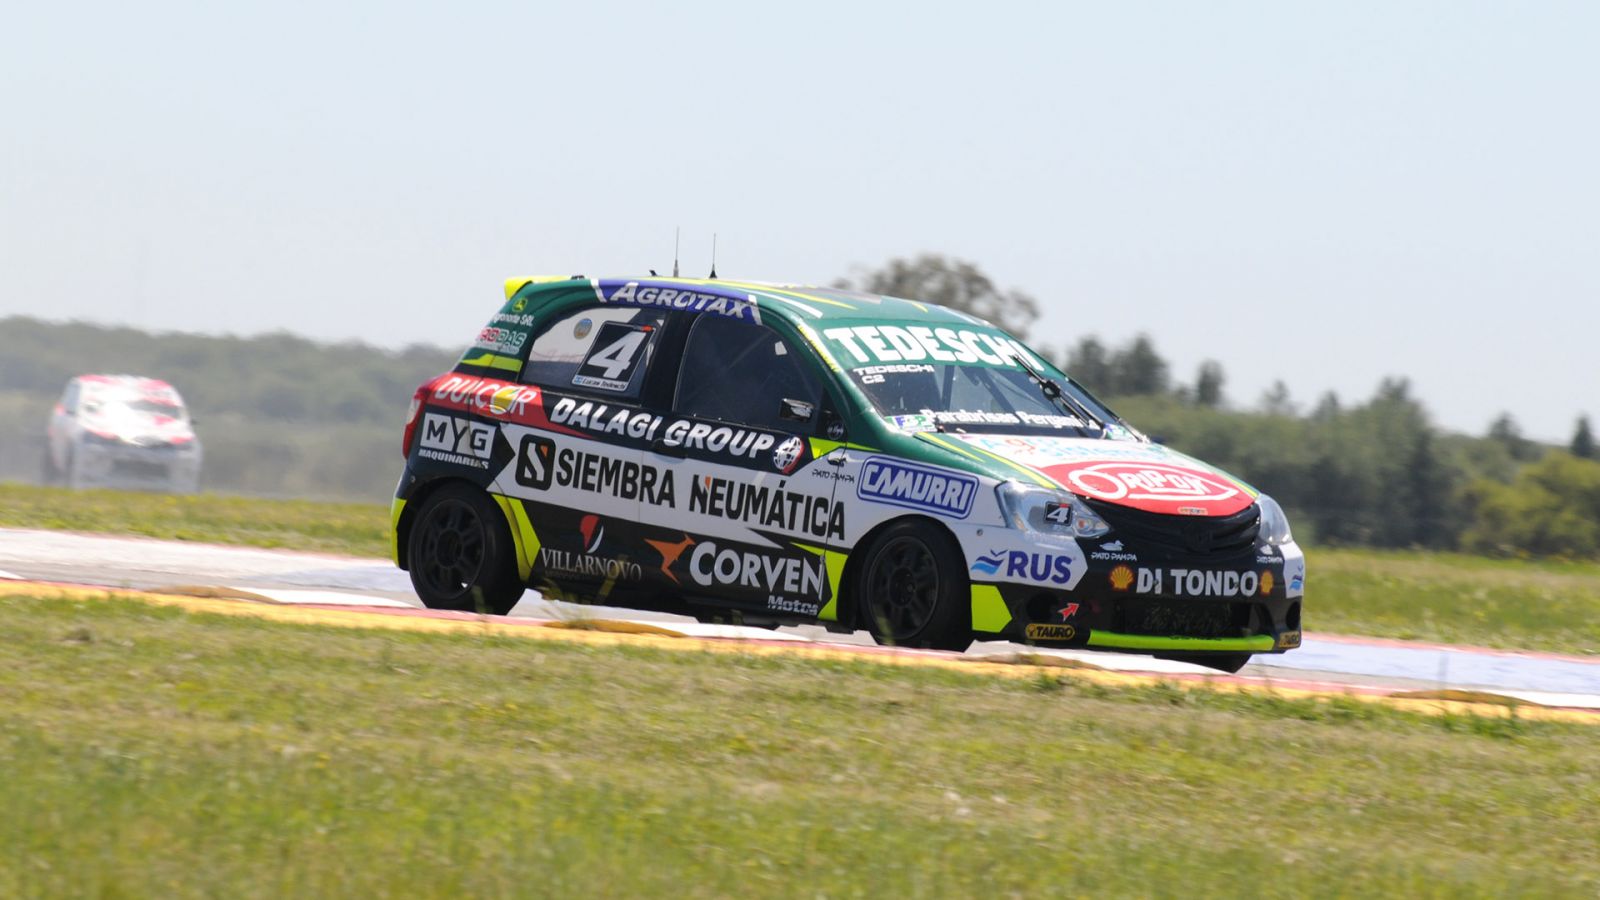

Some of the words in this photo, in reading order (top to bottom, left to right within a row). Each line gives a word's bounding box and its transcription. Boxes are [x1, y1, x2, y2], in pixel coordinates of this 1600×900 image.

[609, 282, 749, 318] AGROTAX
[587, 331, 646, 379] 4
[823, 326, 1044, 371] TEDESCHI
[853, 365, 934, 376] TEDESCHI
[862, 375, 885, 384] C2
[426, 417, 489, 452] MYG
[551, 398, 663, 440] DALAGI
[665, 420, 775, 458] GROUP
[419, 449, 489, 469] MAQUINARIAS
[556, 449, 675, 508] SIEMBRA
[689, 474, 845, 540] NEUMÁTICA
[861, 464, 974, 511] CAMURRI
[1047, 507, 1069, 523] 4
[541, 548, 642, 580] VILLARNOVO
[690, 541, 824, 600] CORVEN
[1007, 551, 1073, 584] RUS
[1136, 568, 1162, 594] DI
[1170, 569, 1258, 596] TONDO
[1037, 626, 1074, 638] TAURO
